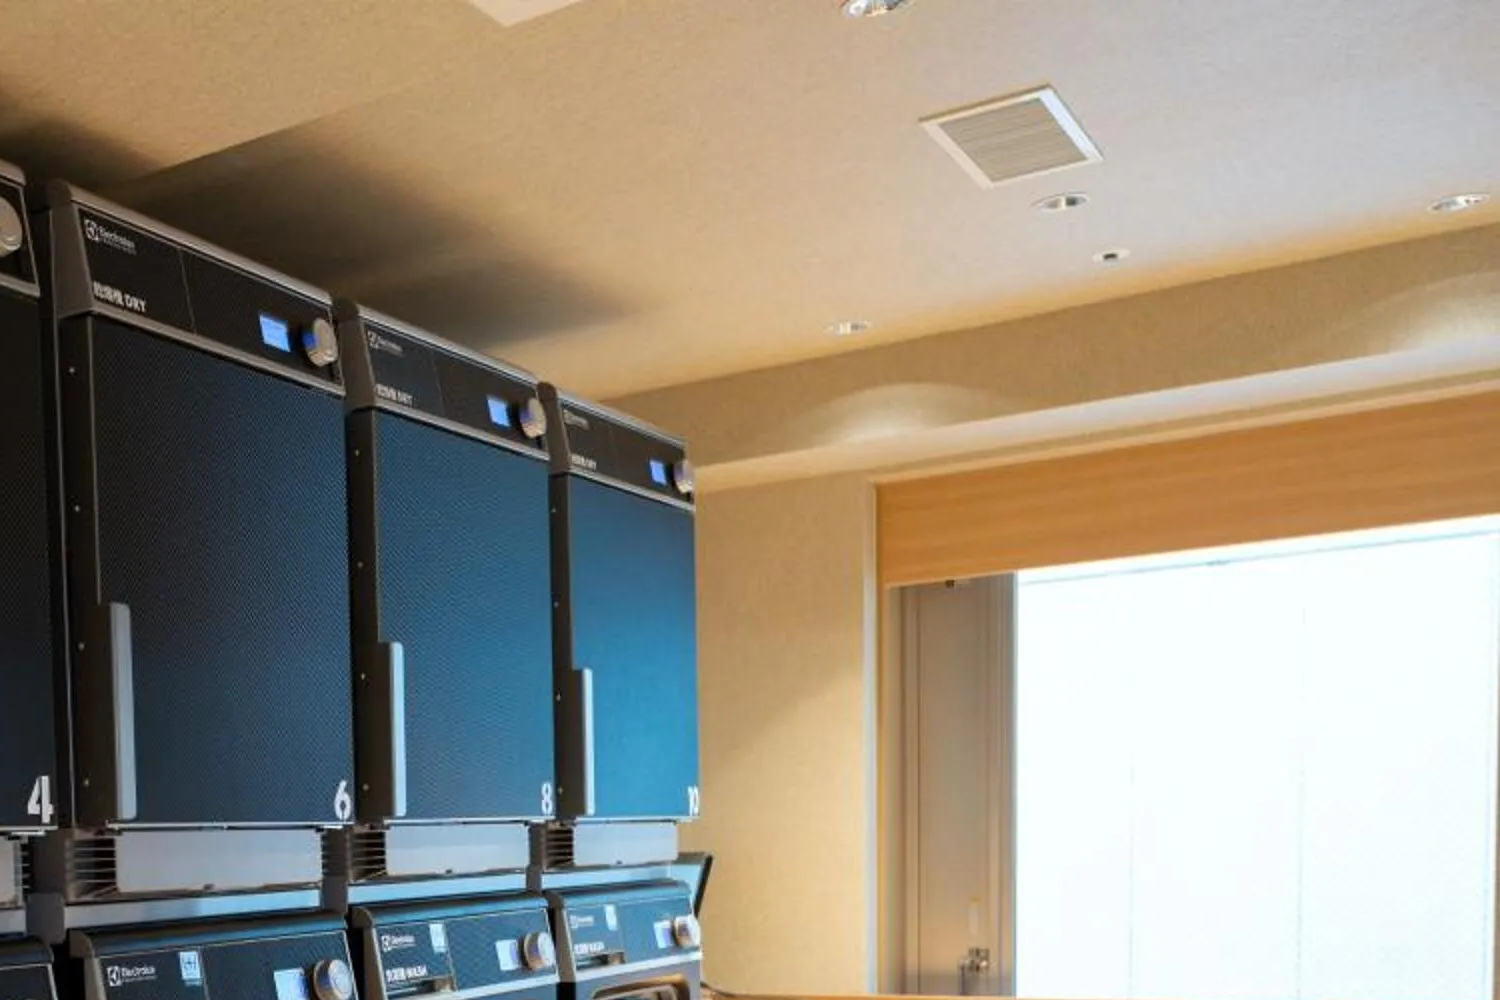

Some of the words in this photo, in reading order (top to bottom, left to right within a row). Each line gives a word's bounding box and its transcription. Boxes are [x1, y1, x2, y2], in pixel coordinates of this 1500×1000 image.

[27, 775, 54, 824] 4
[334, 780, 351, 823] 6
[541, 782, 553, 815] 8
